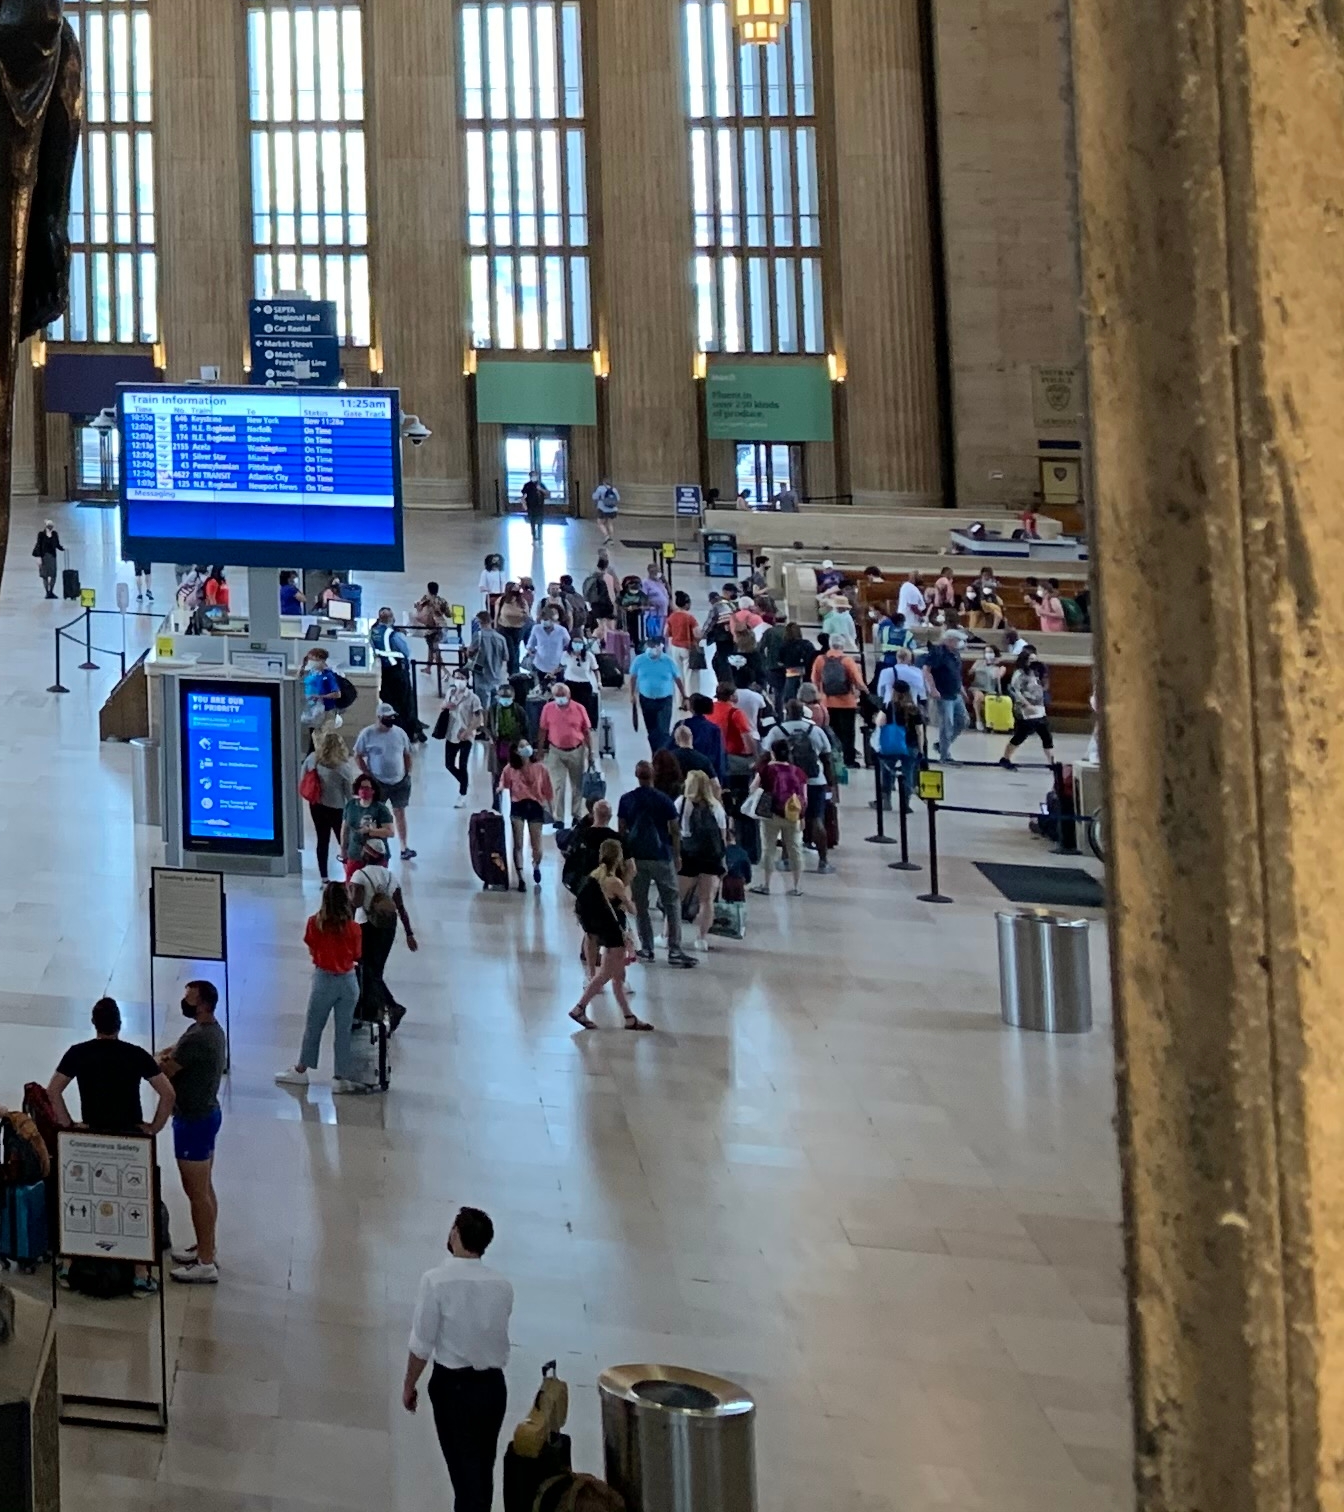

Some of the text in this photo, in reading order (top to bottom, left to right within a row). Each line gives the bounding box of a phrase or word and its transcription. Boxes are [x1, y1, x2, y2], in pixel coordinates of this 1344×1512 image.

[273, 306, 296, 314] SEPTA
[274, 314, 305, 322] Regional
[287, 325, 311, 333] Rental
[264, 340, 313, 348] Market Street
[132, 395, 227, 406] Train Information
[340, 399, 386, 409] 11:25am
[754, 400, 779, 409] kinds
[343, 410, 362, 418] Gate
[365, 410, 386, 418] Track
[191, 416, 222, 424] Keystone
[206, 424, 236, 434] Regional
[303, 427, 314, 435] On
[315, 427, 332, 435] Time
[206, 434, 236, 443] Regional
[247, 435, 271, 443] Boston
[316, 437, 333, 445] Time
[247, 445, 287, 454] Washington
[304, 446, 315, 454] On
[316, 446, 333, 454] Time
[316, 456, 333, 464] Time
[192, 462, 240, 471] Pennsylvanian
[305, 465, 316, 473] On
[317, 465, 334, 473] Time
[248, 473, 274, 481] Atlantic
[275, 474, 288, 482] City
[305, 475, 316, 483] On
[317, 475, 334, 483] Time
[208, 482, 238, 491] Regional
[279, 483, 298, 491] News
[306, 484, 317, 492] On
[317, 484, 334, 492] Time
[135, 489, 175, 499] Messaging
[193, 696, 244, 705] YOU ARE OUR
[204, 705, 240, 713] PRIORITY
[69, 1140, 141, 1153] Coronavirus Safety
